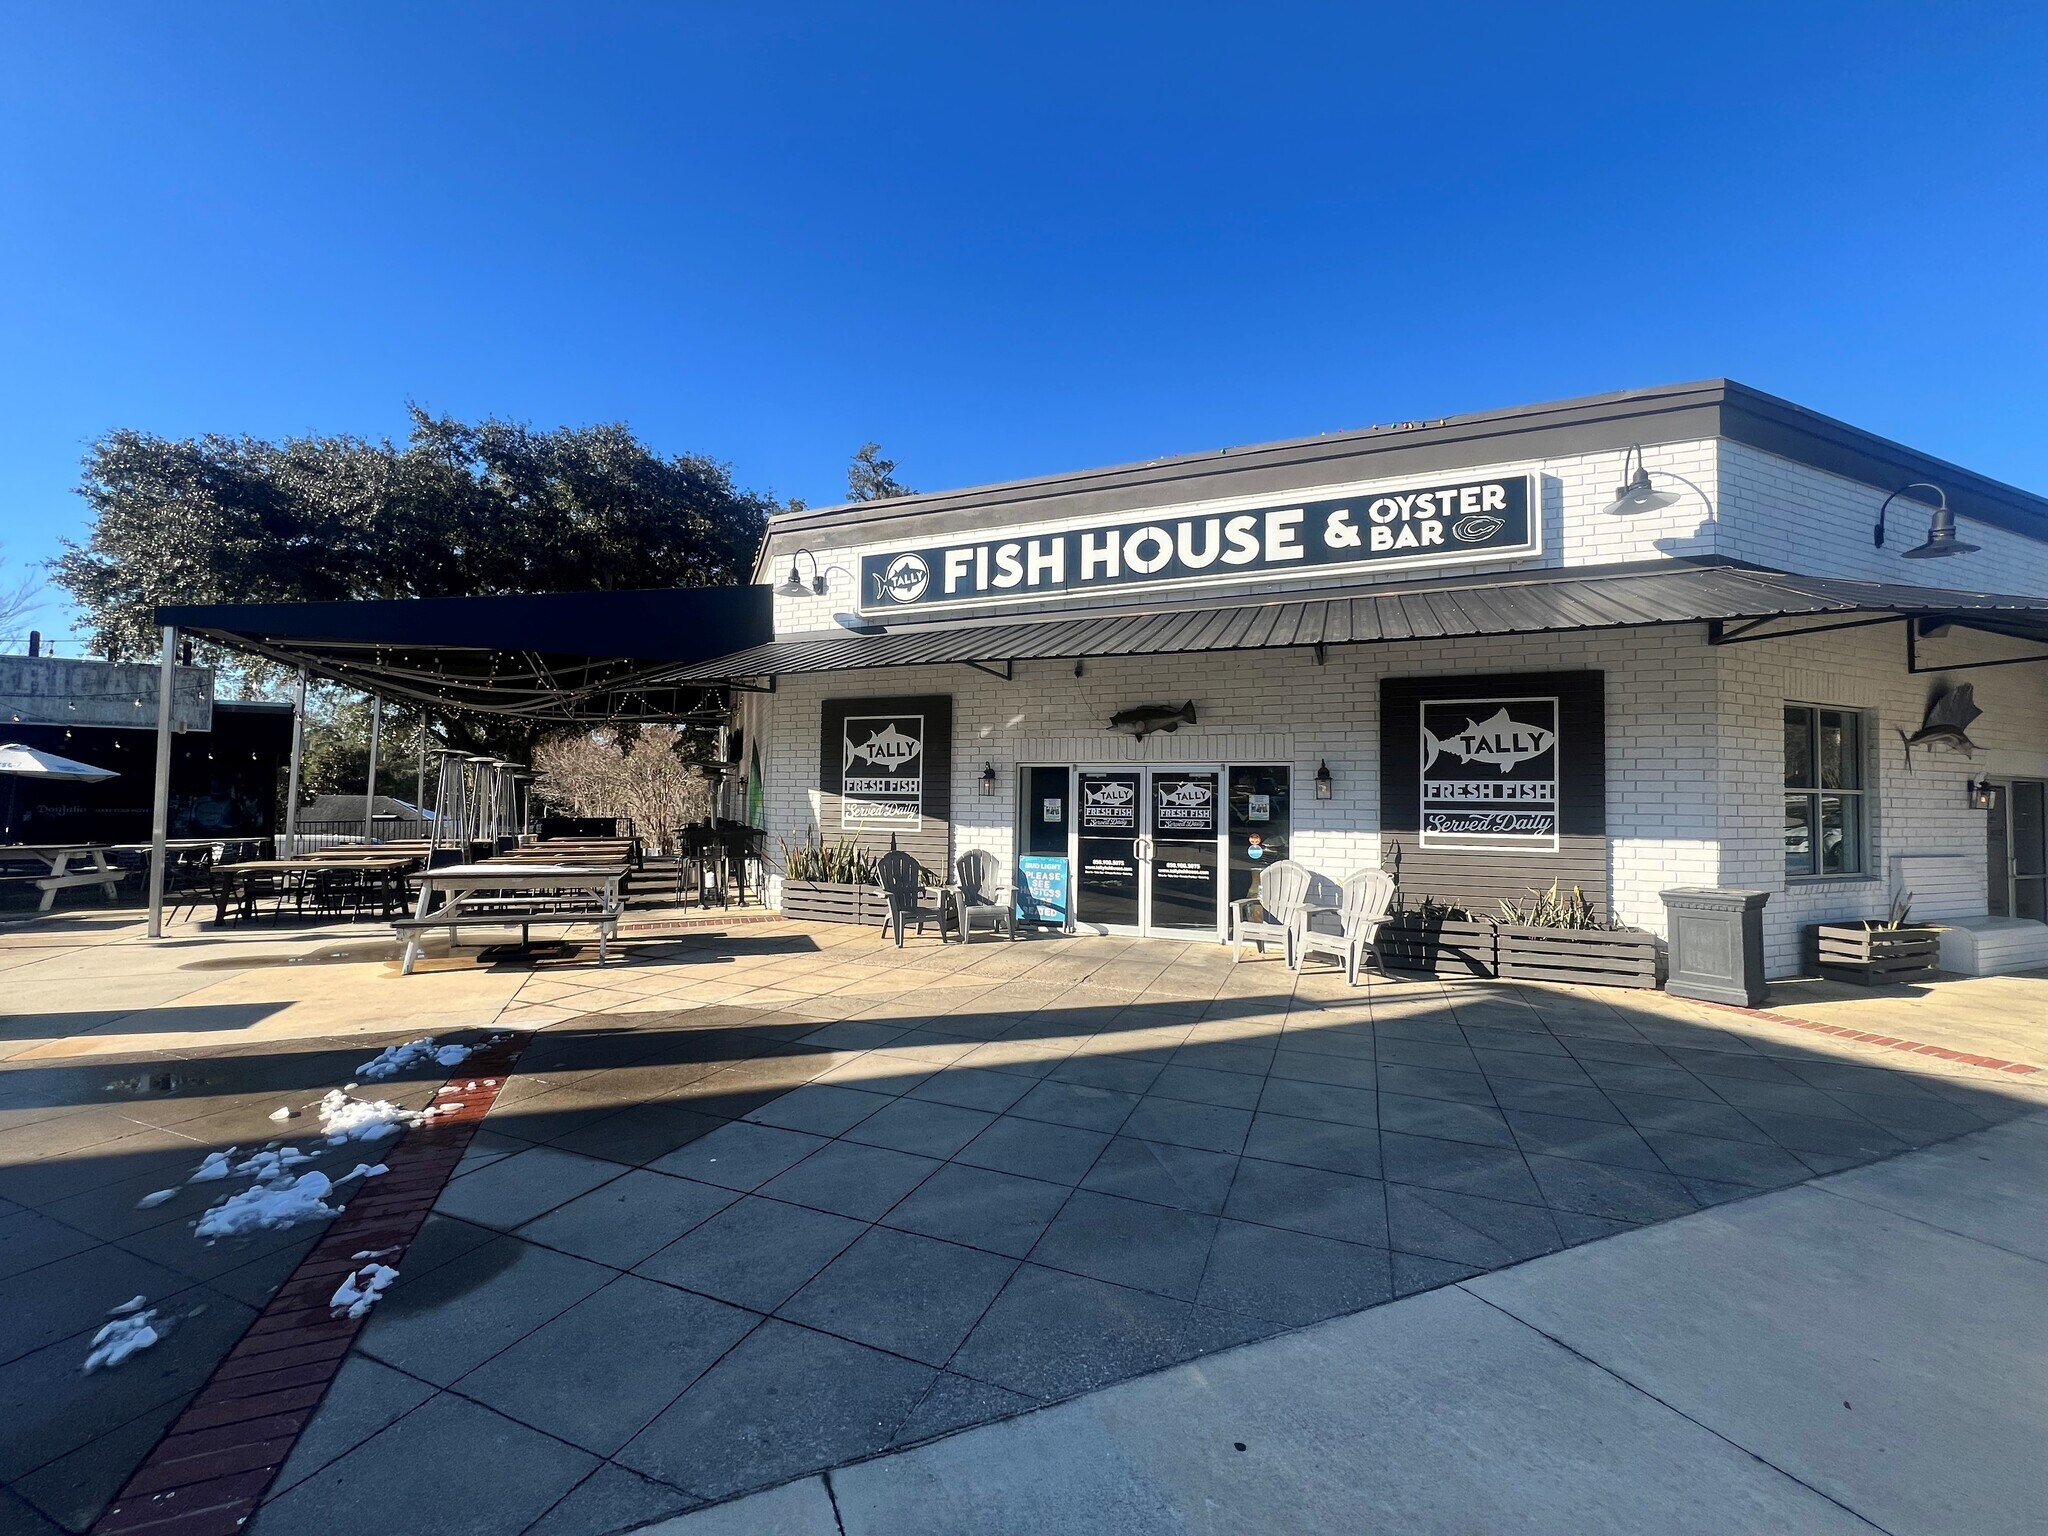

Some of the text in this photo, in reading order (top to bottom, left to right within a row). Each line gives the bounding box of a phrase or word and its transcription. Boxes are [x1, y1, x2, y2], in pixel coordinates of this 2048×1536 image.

[945, 485, 1507, 594] FISH HOUSE & OYSTER
[1370, 520, 1445, 552] BAR
[891, 570, 924, 588] TALLY
[866, 741, 915, 758] TALLY
[1460, 732, 1545, 754] TALLY
[846, 780, 918, 792] FRESH FISH
[1428, 784, 1551, 799] FRESH FISH
[1100, 790, 1130, 800] TALLY
[1175, 790, 1207, 801] TALLY
[845, 802, 918, 820] Served Daily
[1086, 808, 1132, 817] FRESH FISH
[1160, 809, 1210, 818] FRESH FISH
[1427, 814, 1553, 835] Served Daily
[1025, 871, 1060, 880] PLEASE
[1032, 880, 1050, 889] SEE
